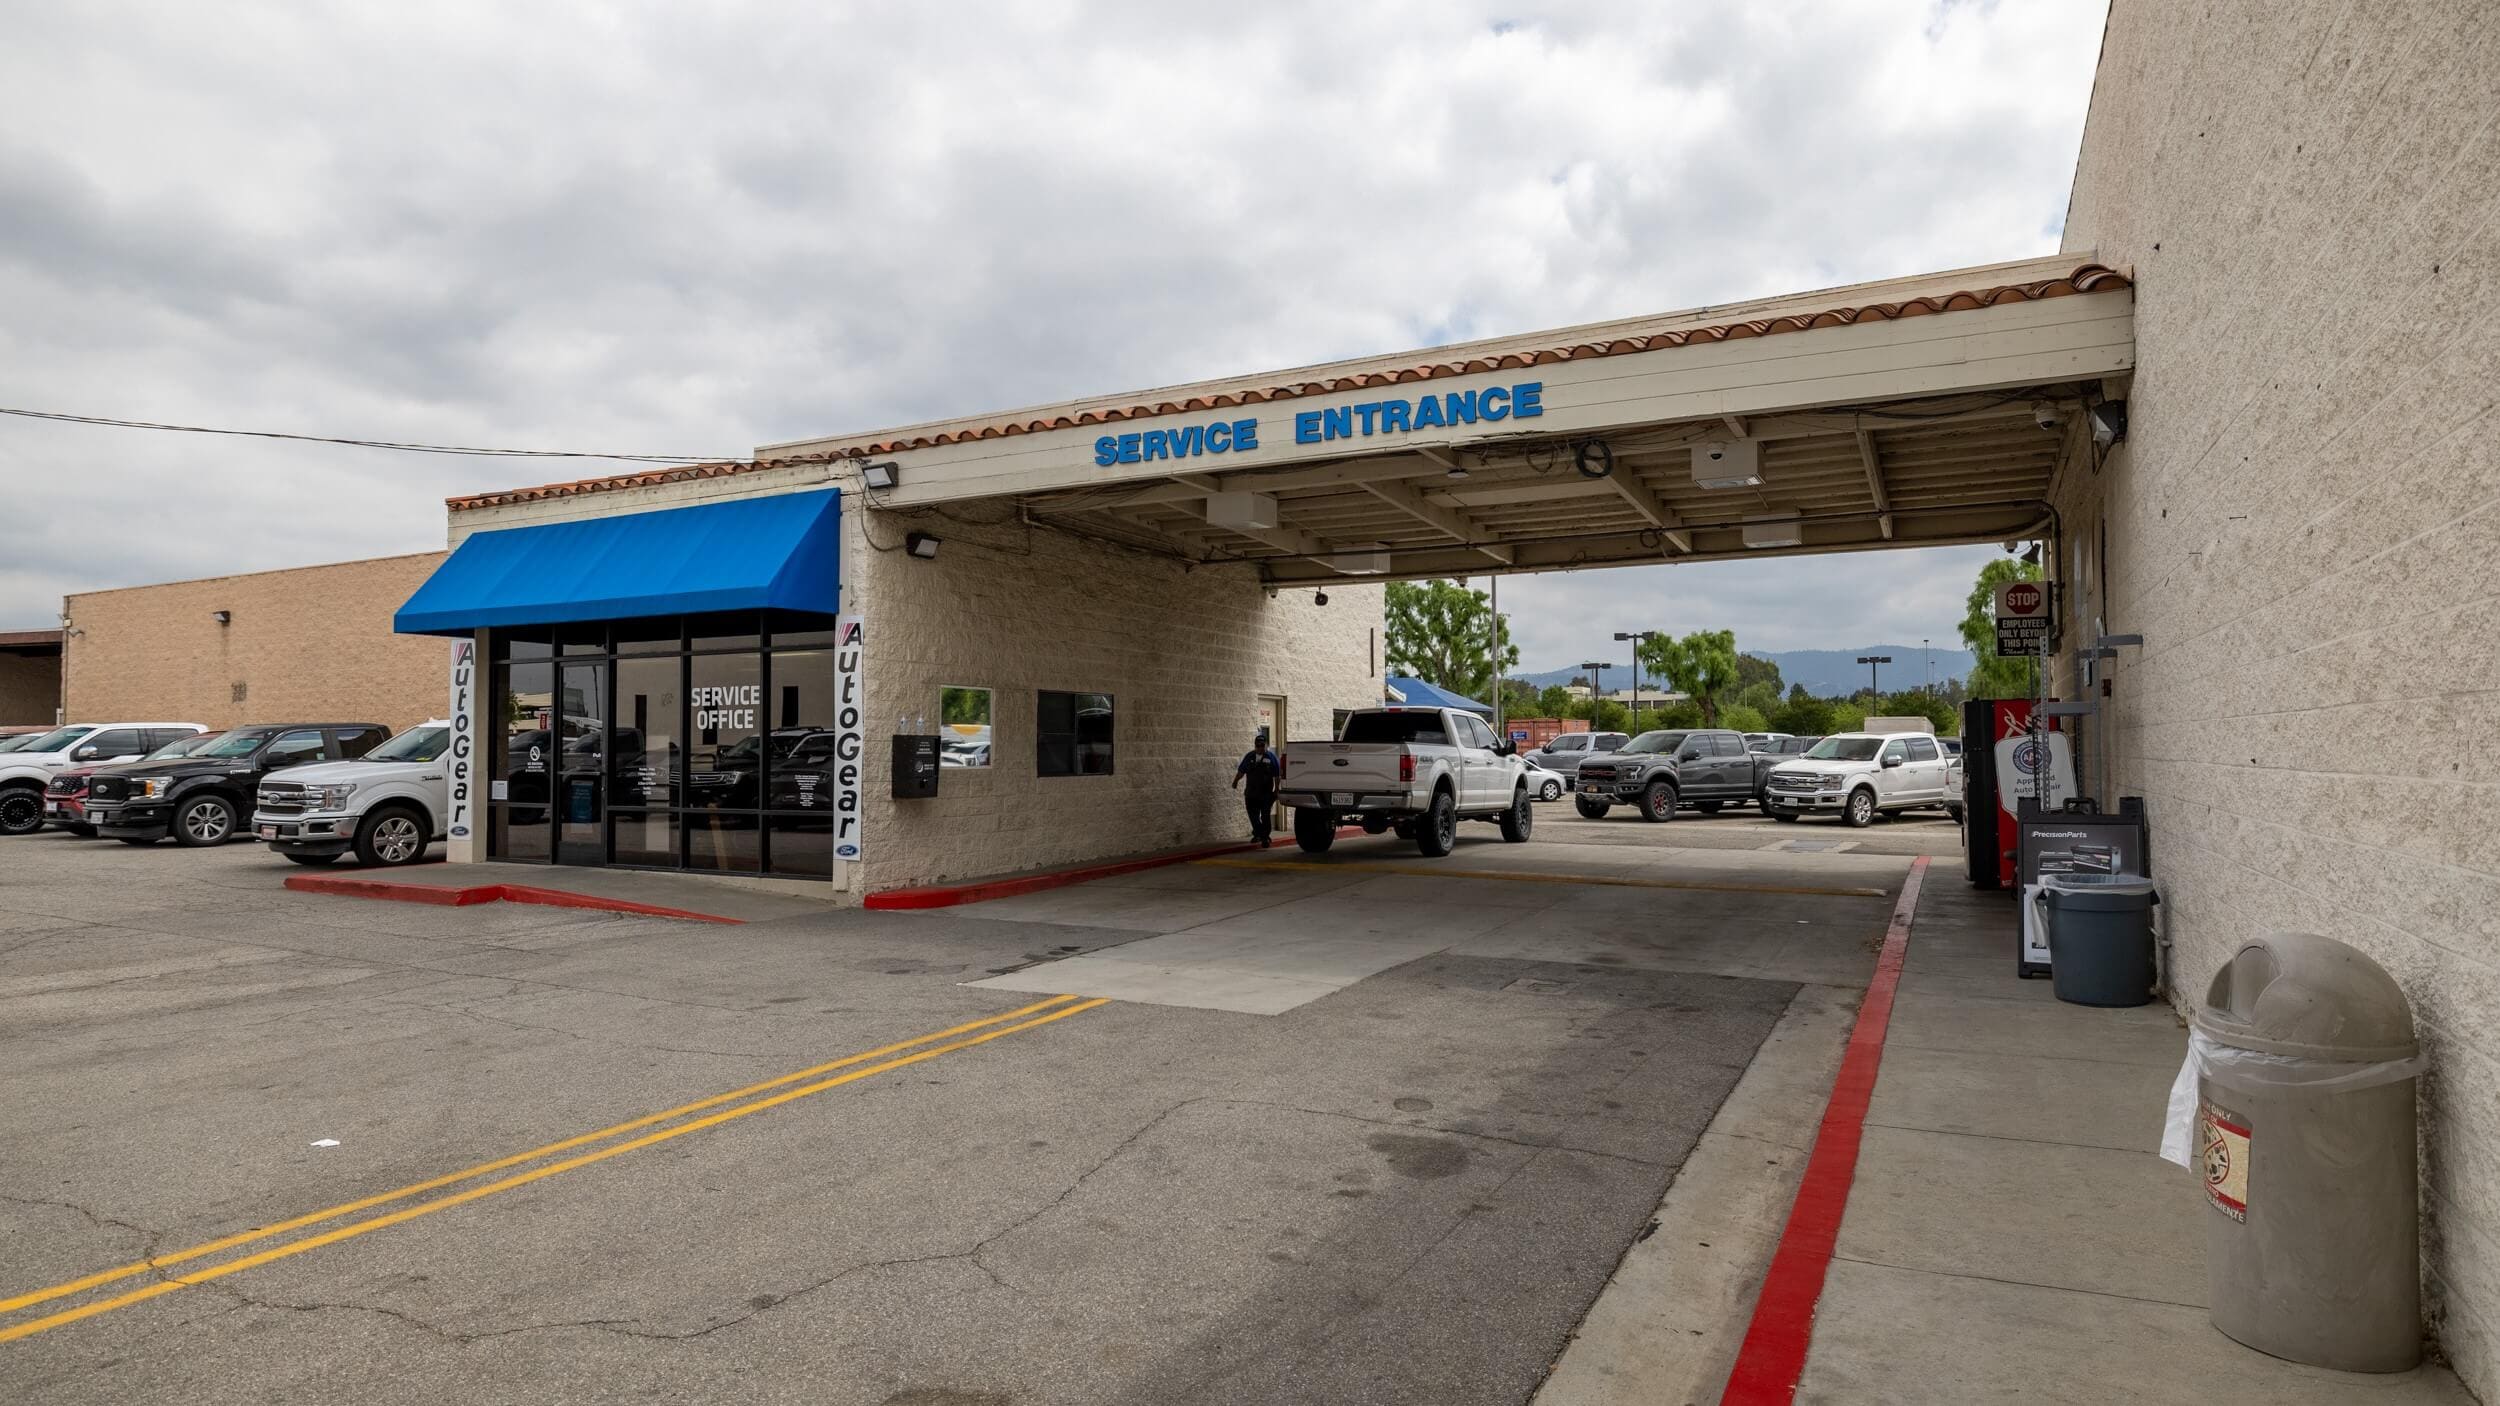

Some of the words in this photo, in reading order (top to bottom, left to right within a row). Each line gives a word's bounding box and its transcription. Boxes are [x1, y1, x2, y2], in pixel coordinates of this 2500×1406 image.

[1094, 418, 1258, 467] SERVICE
[1295, 382, 1543, 445] ENTRANCE
[2007, 592, 2040, 607] STOP
[1998, 629, 2019, 638] ONLY
[2002, 619, 2046, 629] EMPLOYEES
[2003, 639, 2021, 648] THIS
[691, 685, 760, 707] SERVICE
[697, 709, 754, 730] OFFICE
[454, 643, 475, 823] AutoGear
[837, 623, 862, 838] AutoGear
[2211, 1104, 2231, 1121] ONLY
